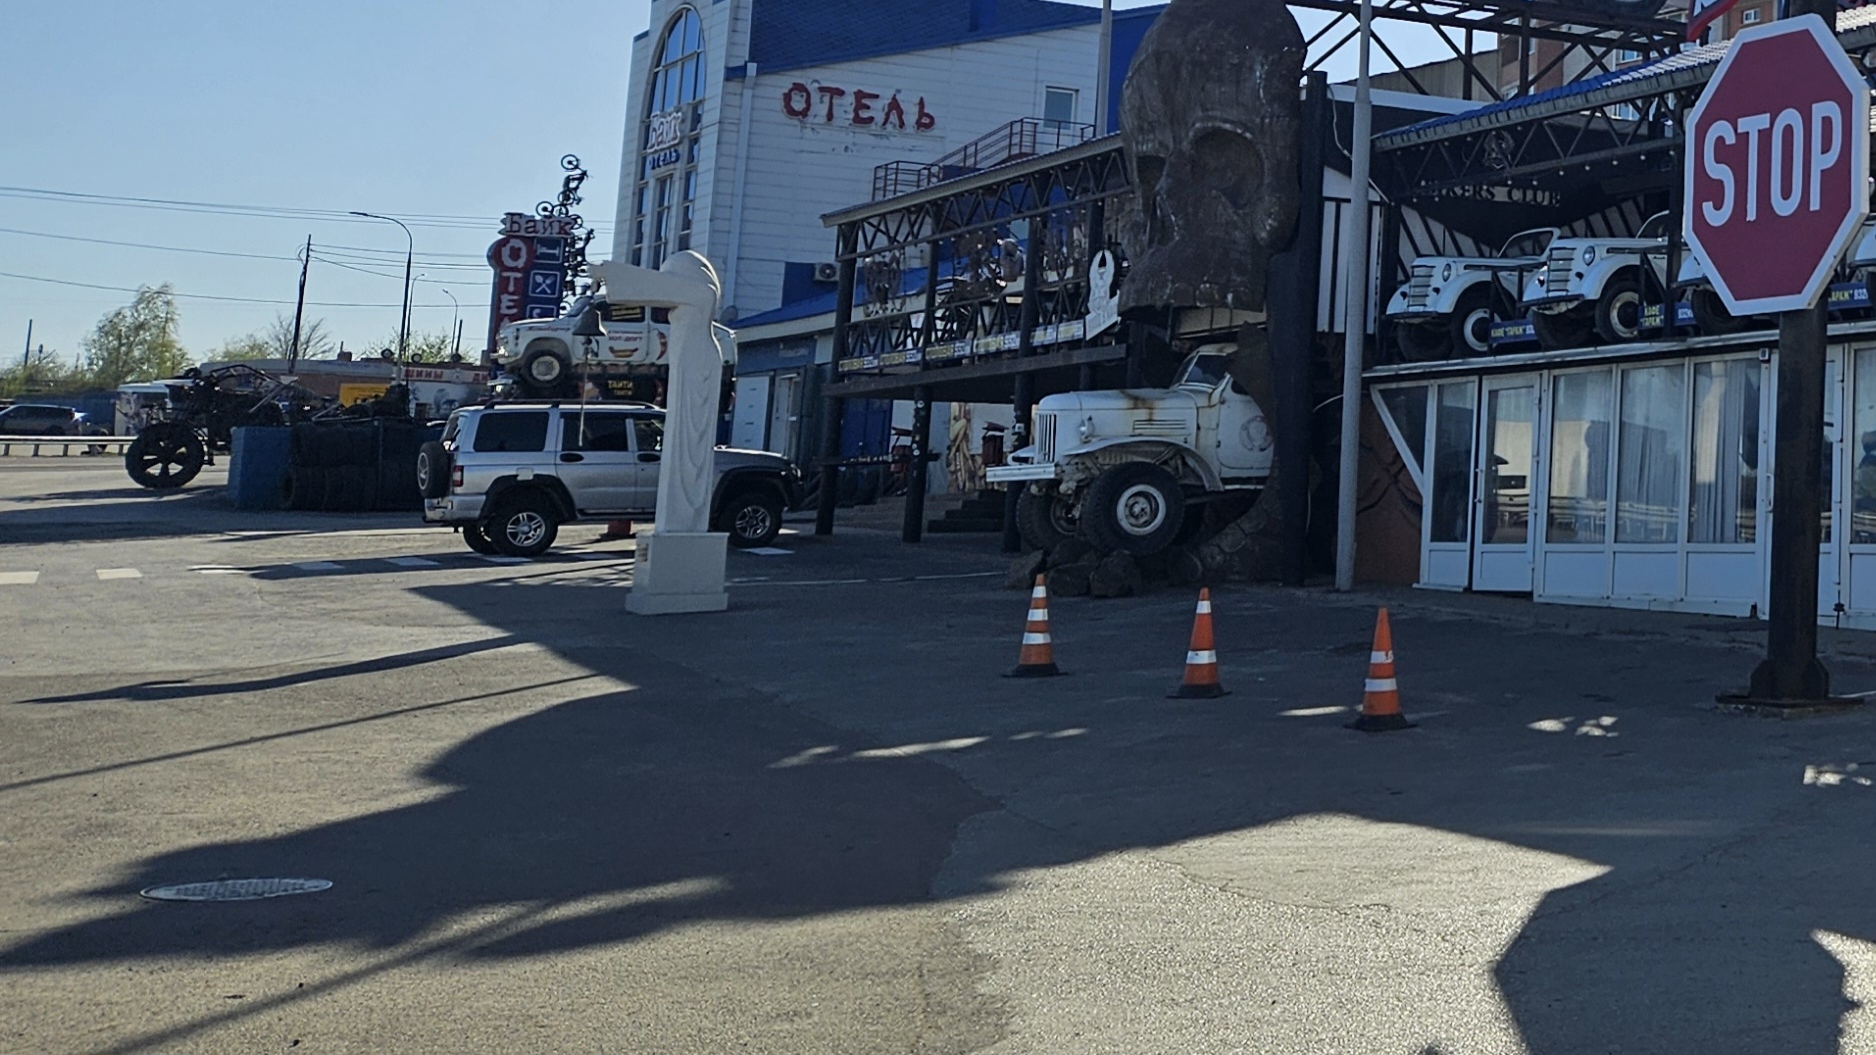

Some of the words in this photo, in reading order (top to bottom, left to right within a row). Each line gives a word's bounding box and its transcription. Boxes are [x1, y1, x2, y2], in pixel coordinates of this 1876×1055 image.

[782, 81, 936, 132] ОТЕЛЬ
[1702, 100, 1842, 227] STOP
[505, 214, 572, 236] Байк
[501, 238, 528, 324] ОТЕ
